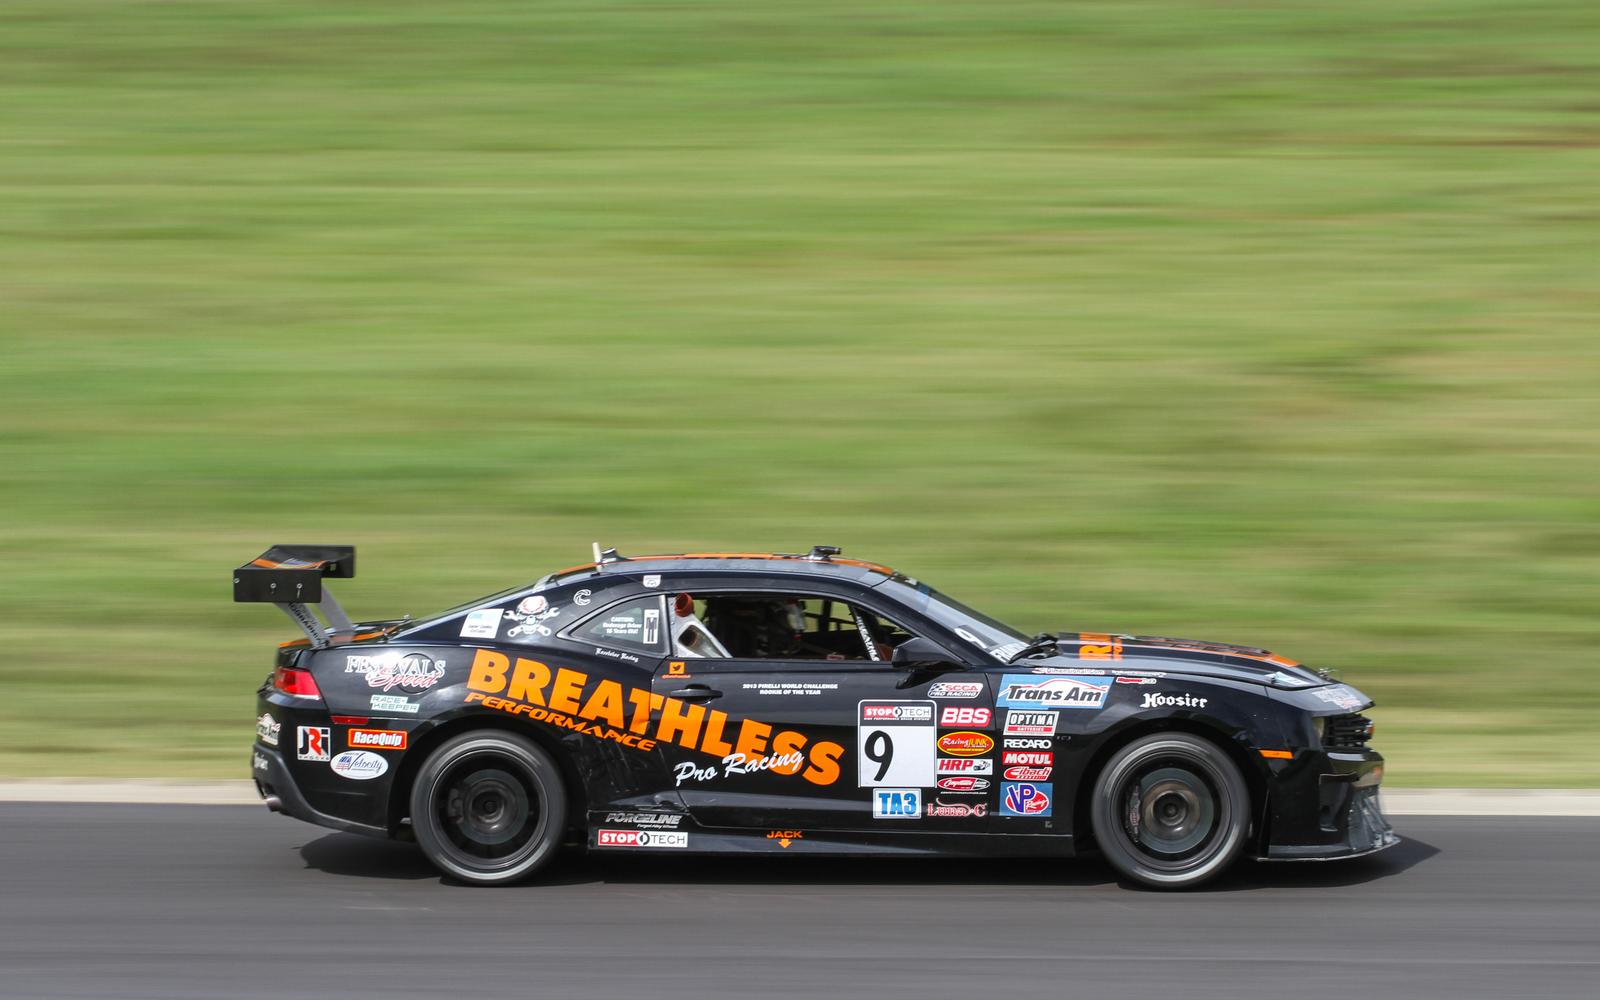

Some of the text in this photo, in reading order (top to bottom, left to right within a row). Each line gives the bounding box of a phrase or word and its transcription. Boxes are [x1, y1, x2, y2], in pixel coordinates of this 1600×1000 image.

[1008, 685, 1101, 701] Trans Am
[1139, 692, 1208, 708] Hoosier
[465, 648, 846, 787] BREATHLESS
[866, 708, 930, 716] STOP TECH
[941, 708, 990, 724] BBS
[1010, 713, 1053, 726] OPTIMA
[464, 691, 658, 753] PERFORMANCE
[353, 732, 403, 746] RaceQuip
[1004, 739, 1052, 749] RECARO
[864, 730, 894, 782] 9
[1004, 753, 1052, 765] MOTUL
[673, 751, 805, 787] Pro Racing
[939, 759, 974, 771] HRP
[879, 793, 917, 815] TA3
[1007, 784, 1036, 814] VP
[605, 812, 683, 825] FORGELINE
[602, 833, 686, 844] STOP TECH
[766, 830, 803, 839] JACK
